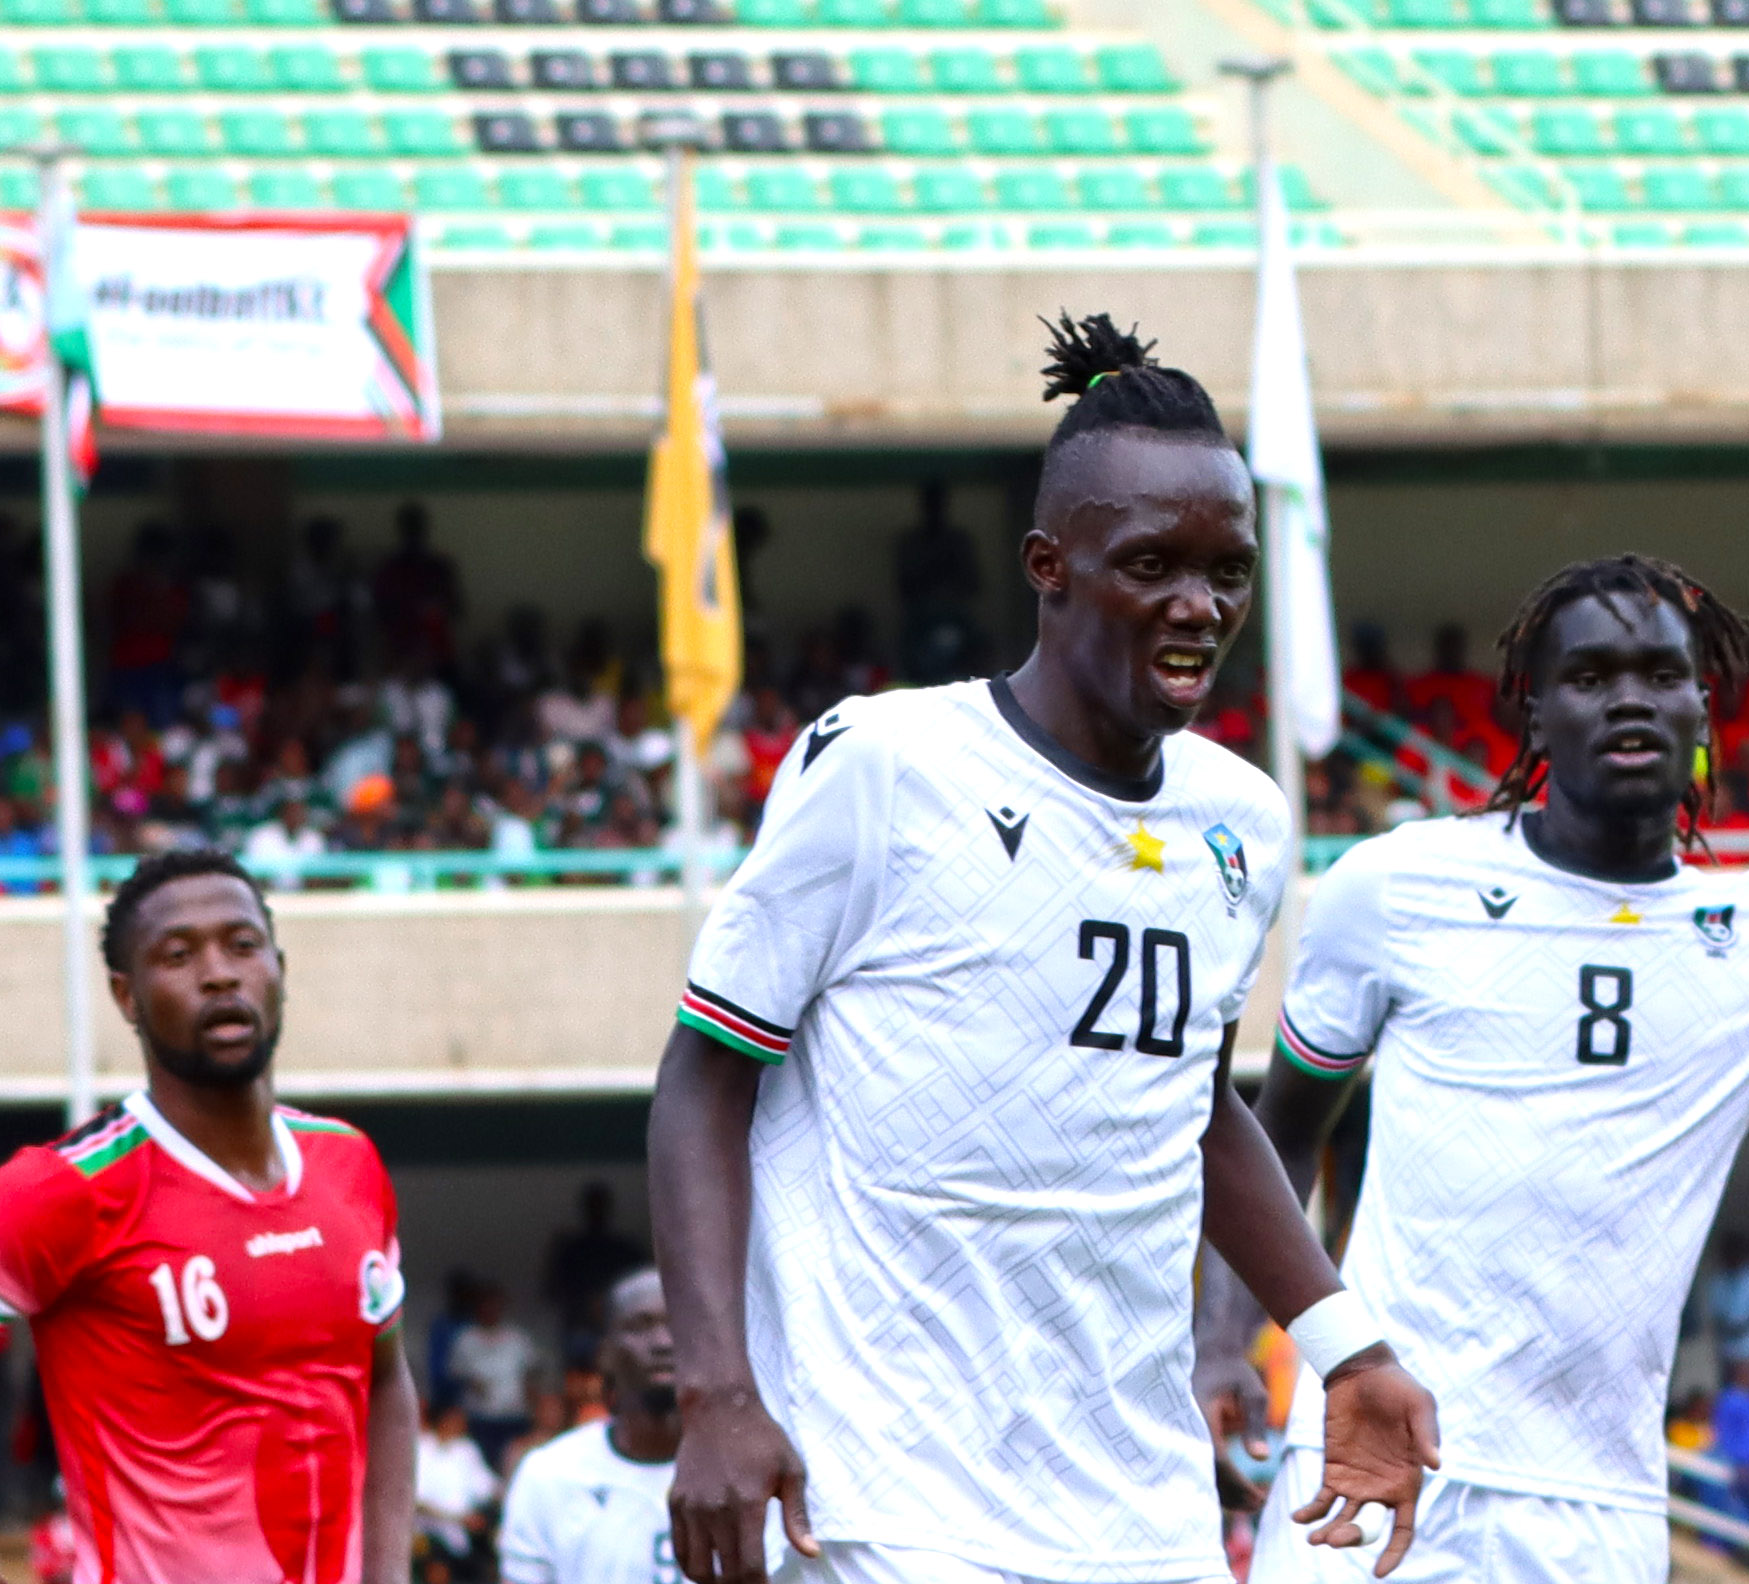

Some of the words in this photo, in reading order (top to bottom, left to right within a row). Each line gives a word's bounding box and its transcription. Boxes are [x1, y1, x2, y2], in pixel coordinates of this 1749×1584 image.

[1070, 919, 1192, 1058] 20
[1576, 963, 1633, 1066] 8
[148, 1255, 230, 1346] 16
